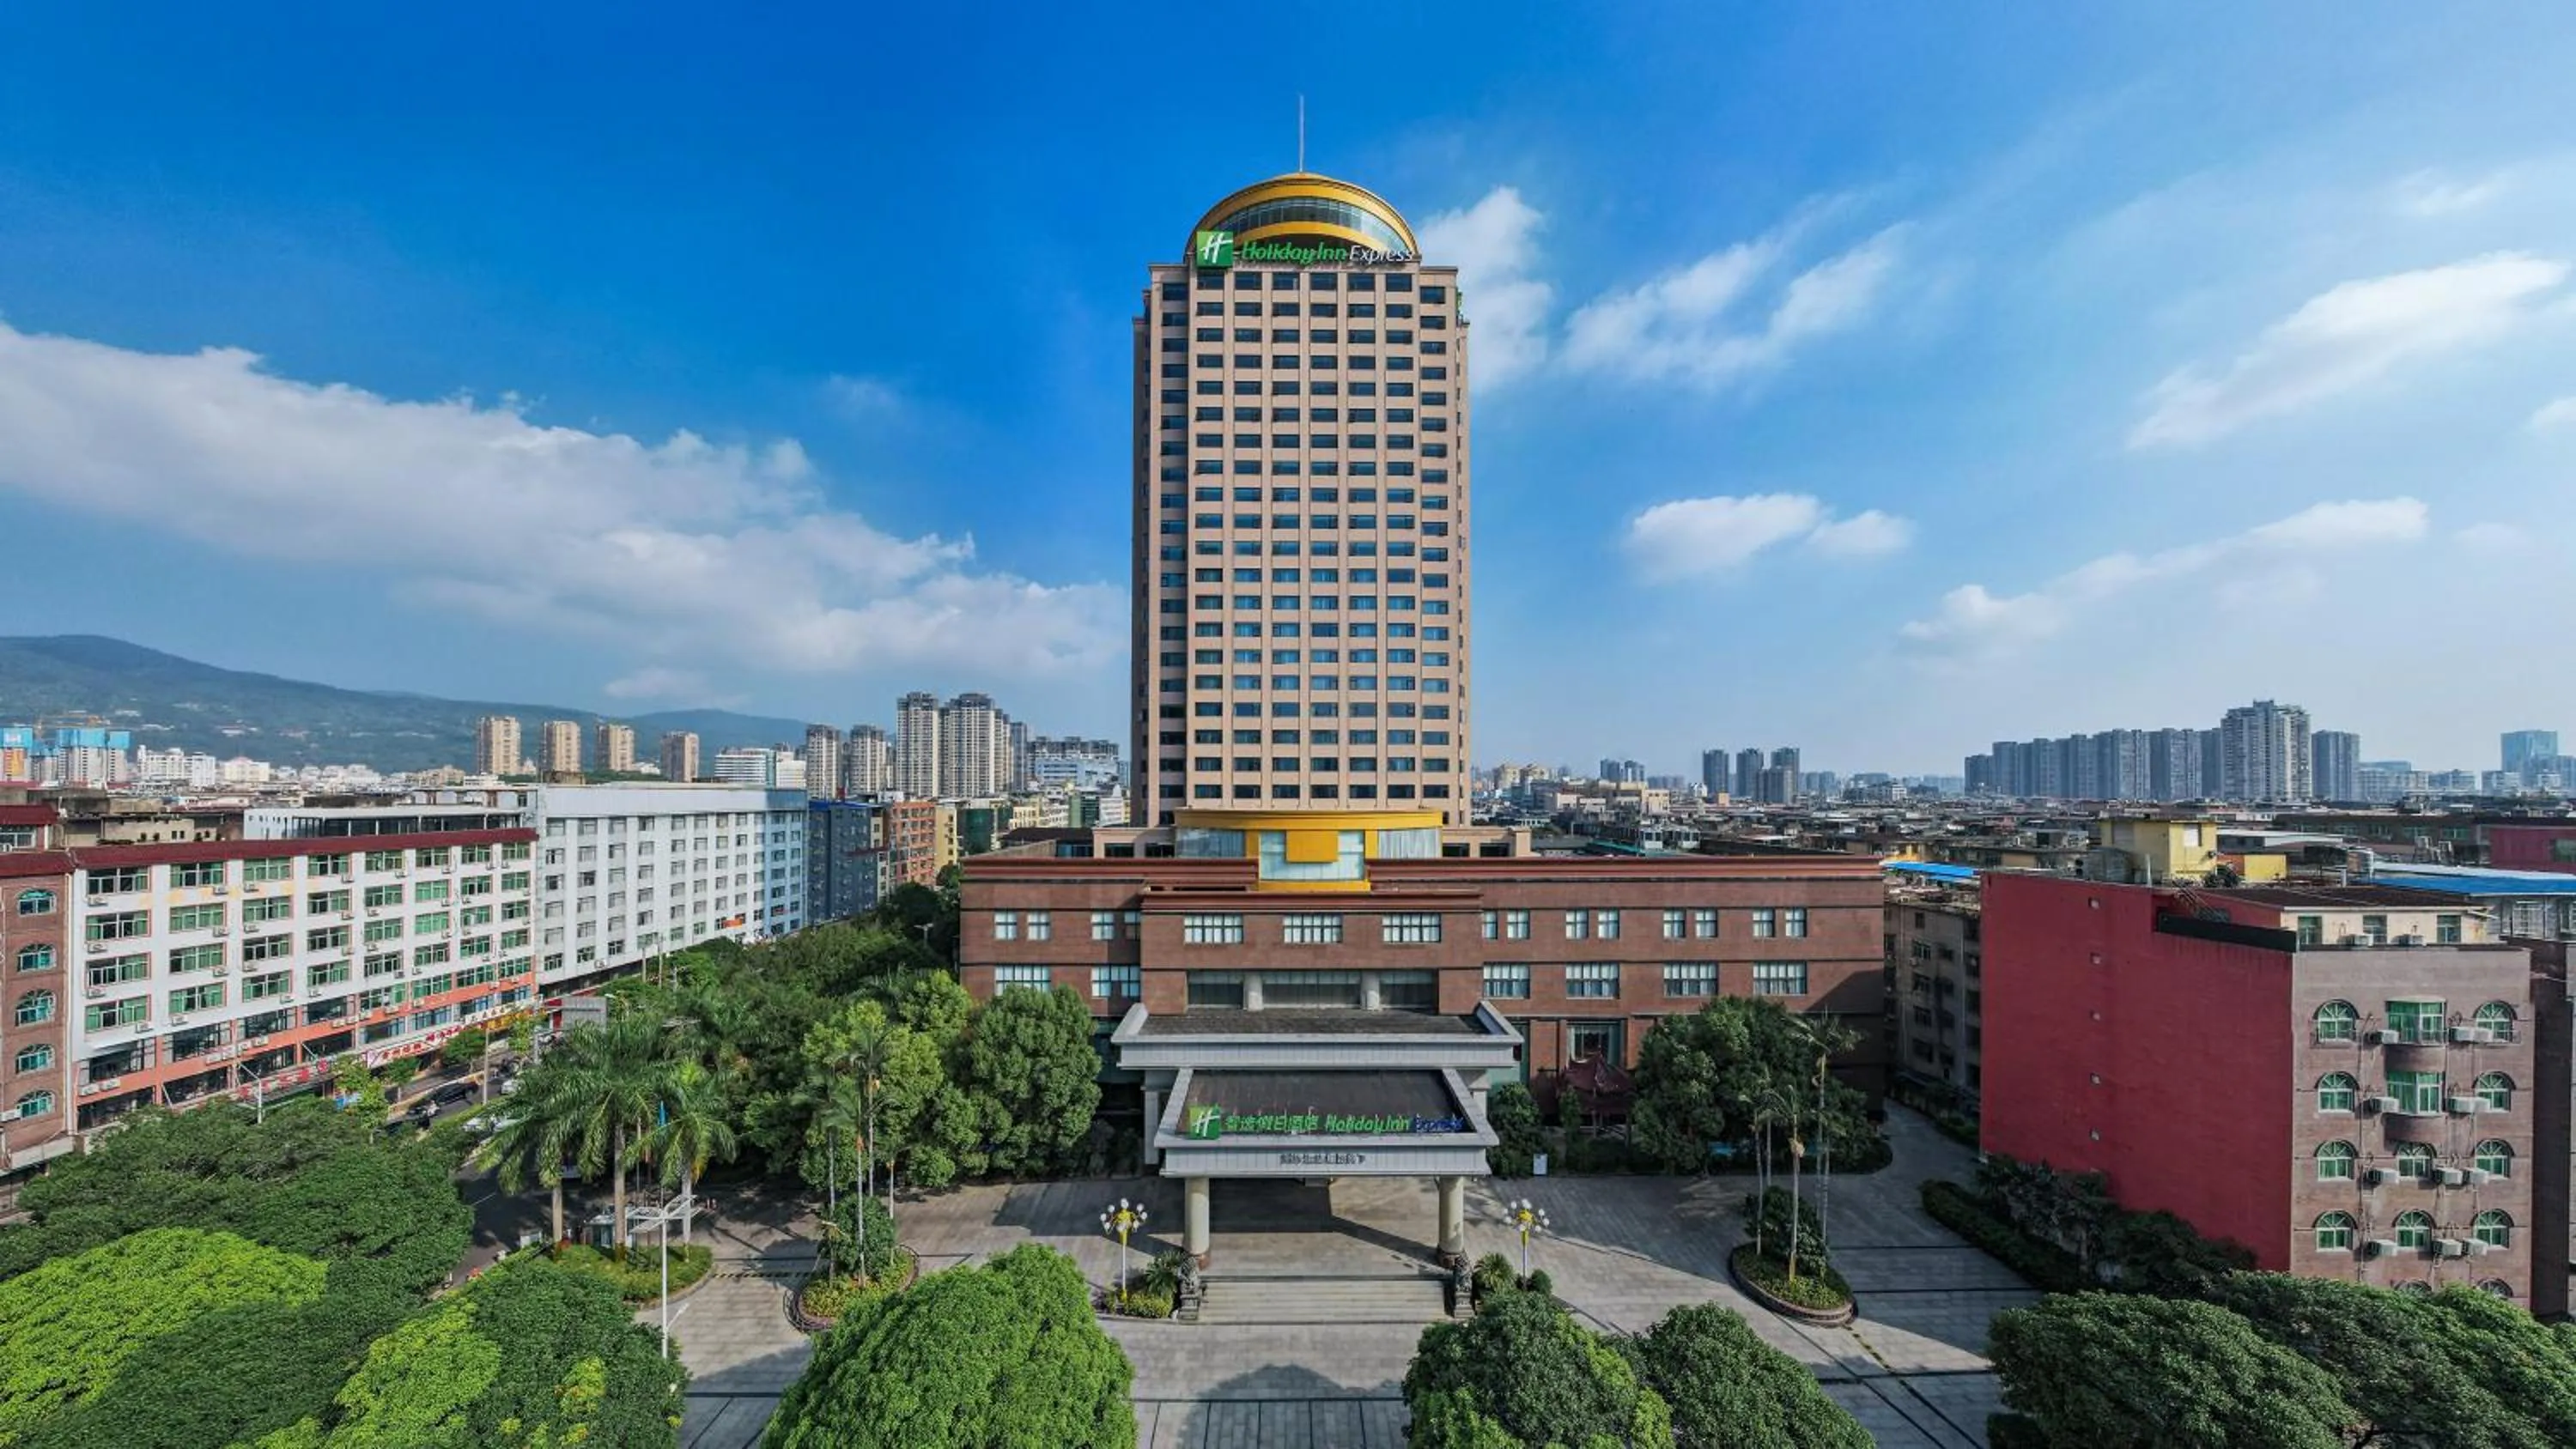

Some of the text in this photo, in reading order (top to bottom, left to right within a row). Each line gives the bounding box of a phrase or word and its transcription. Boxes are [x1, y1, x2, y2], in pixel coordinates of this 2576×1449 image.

[1241, 241, 1413, 265] Holiday Inn Express
[1325, 1113, 1385, 1133] Holiday
